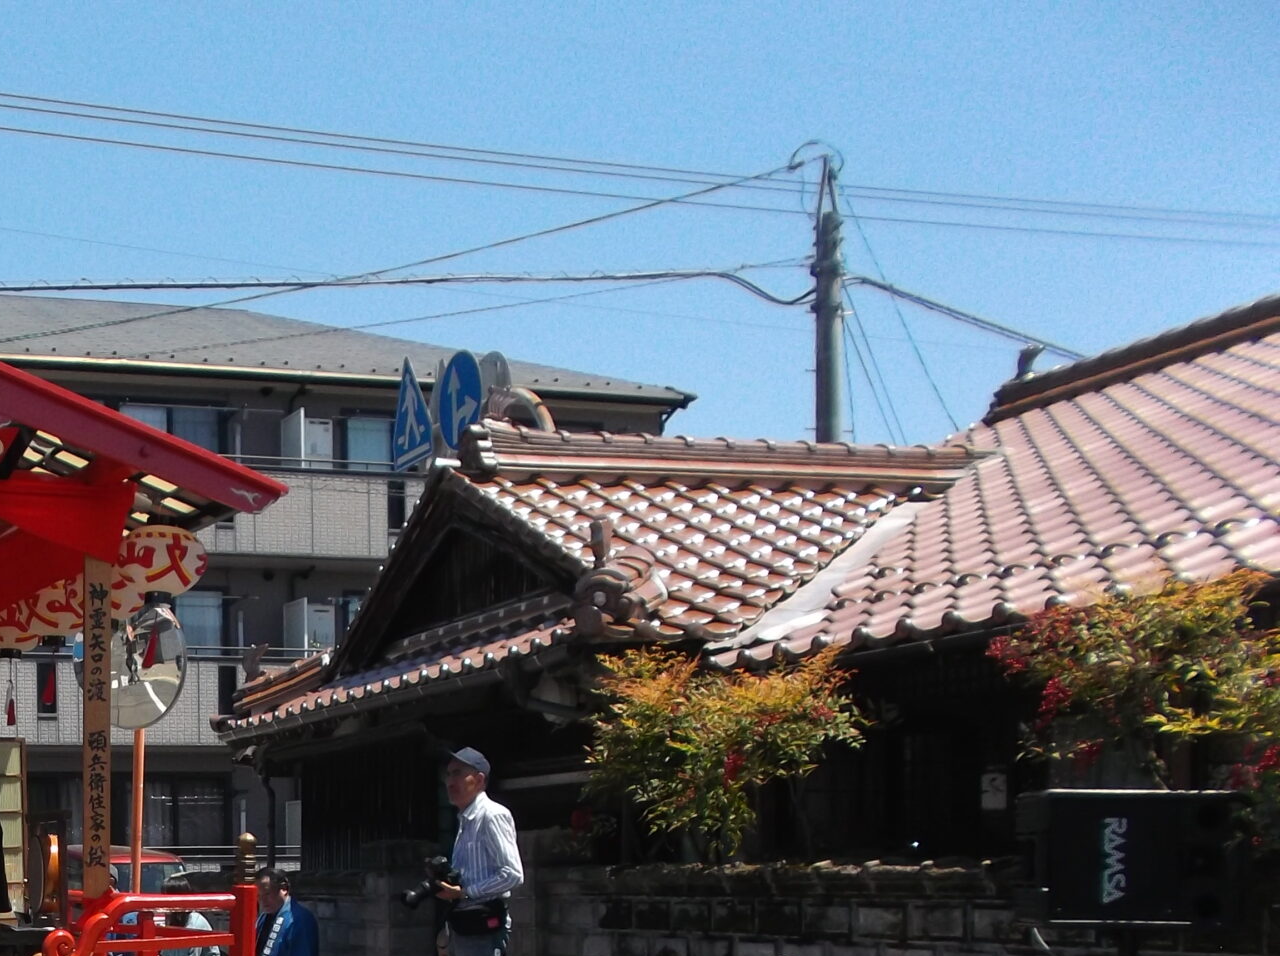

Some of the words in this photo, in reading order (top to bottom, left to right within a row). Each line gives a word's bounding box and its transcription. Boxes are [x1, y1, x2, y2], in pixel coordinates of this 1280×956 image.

[87, 582, 109, 702] 神霊矢口の渡
[1103, 817, 1128, 903] RAMSA
